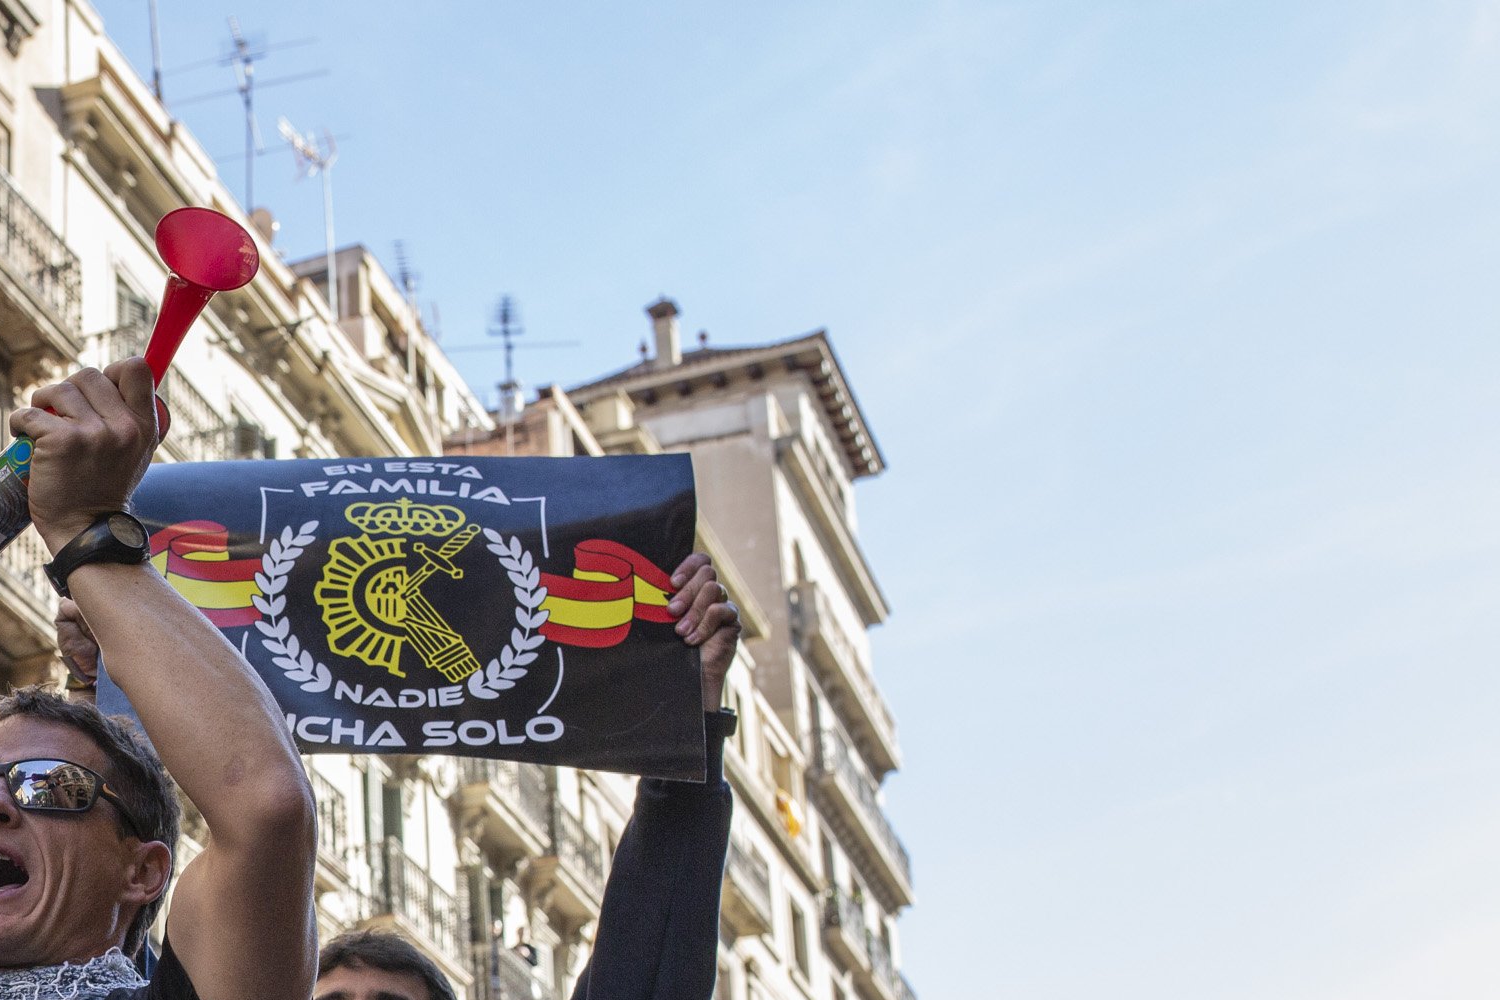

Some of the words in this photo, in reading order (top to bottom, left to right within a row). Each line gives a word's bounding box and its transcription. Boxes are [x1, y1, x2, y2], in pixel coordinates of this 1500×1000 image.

[323, 463, 374, 477] EN
[384, 461, 484, 480] ESTA
[300, 478, 511, 506] FAMILIA
[334, 680, 465, 708] NADIE
[422, 715, 564, 747] SOLO
